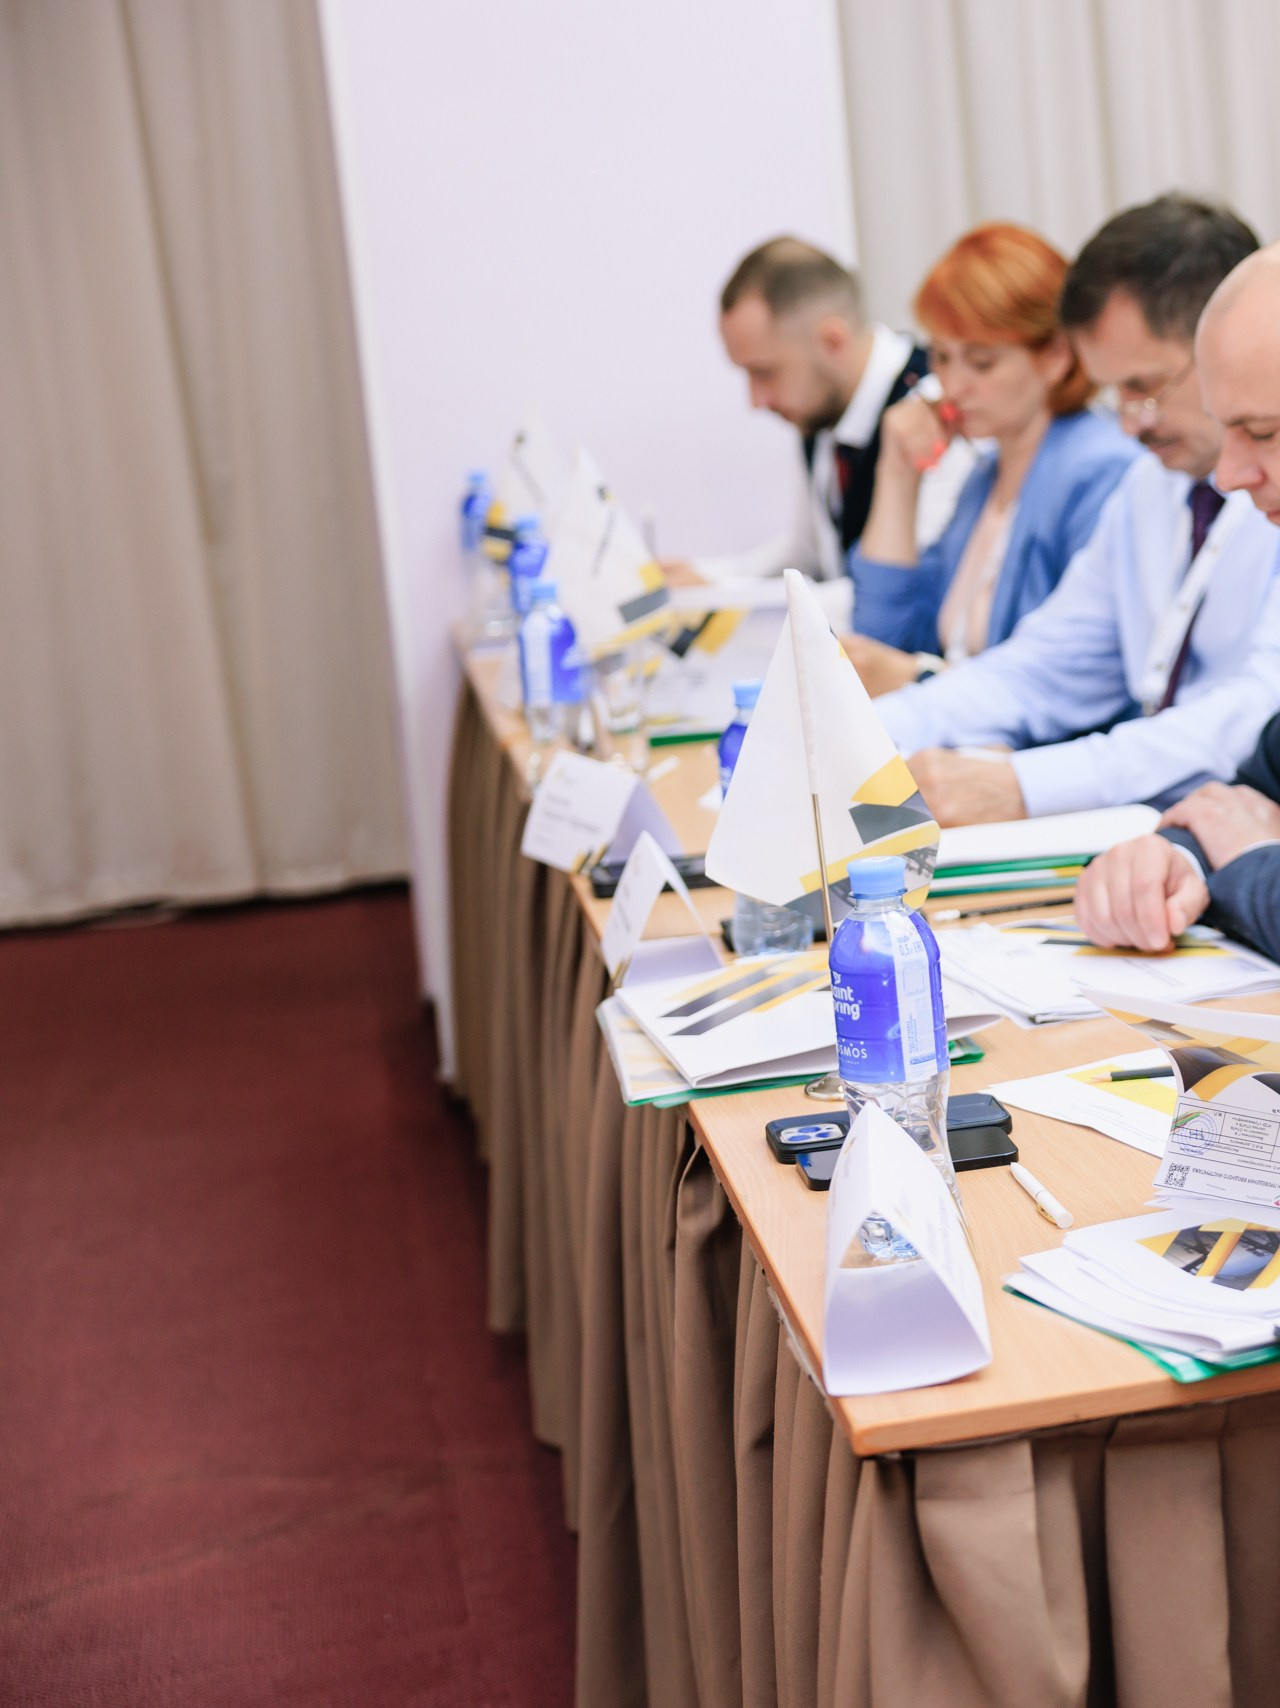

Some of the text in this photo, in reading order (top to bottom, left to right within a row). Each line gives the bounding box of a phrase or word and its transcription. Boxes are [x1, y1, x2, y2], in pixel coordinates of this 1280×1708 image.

[832, 986, 854, 1001] aint
[839, 1044, 867, 1058] SMOS
[1192, 1168, 1223, 1178] ИНСТРУКТАЖА
[1223, 1174, 1247, 1183] ВВОДНОГО
[1247, 1179, 1277, 1188] ПРОВЕДЕНИЯ
